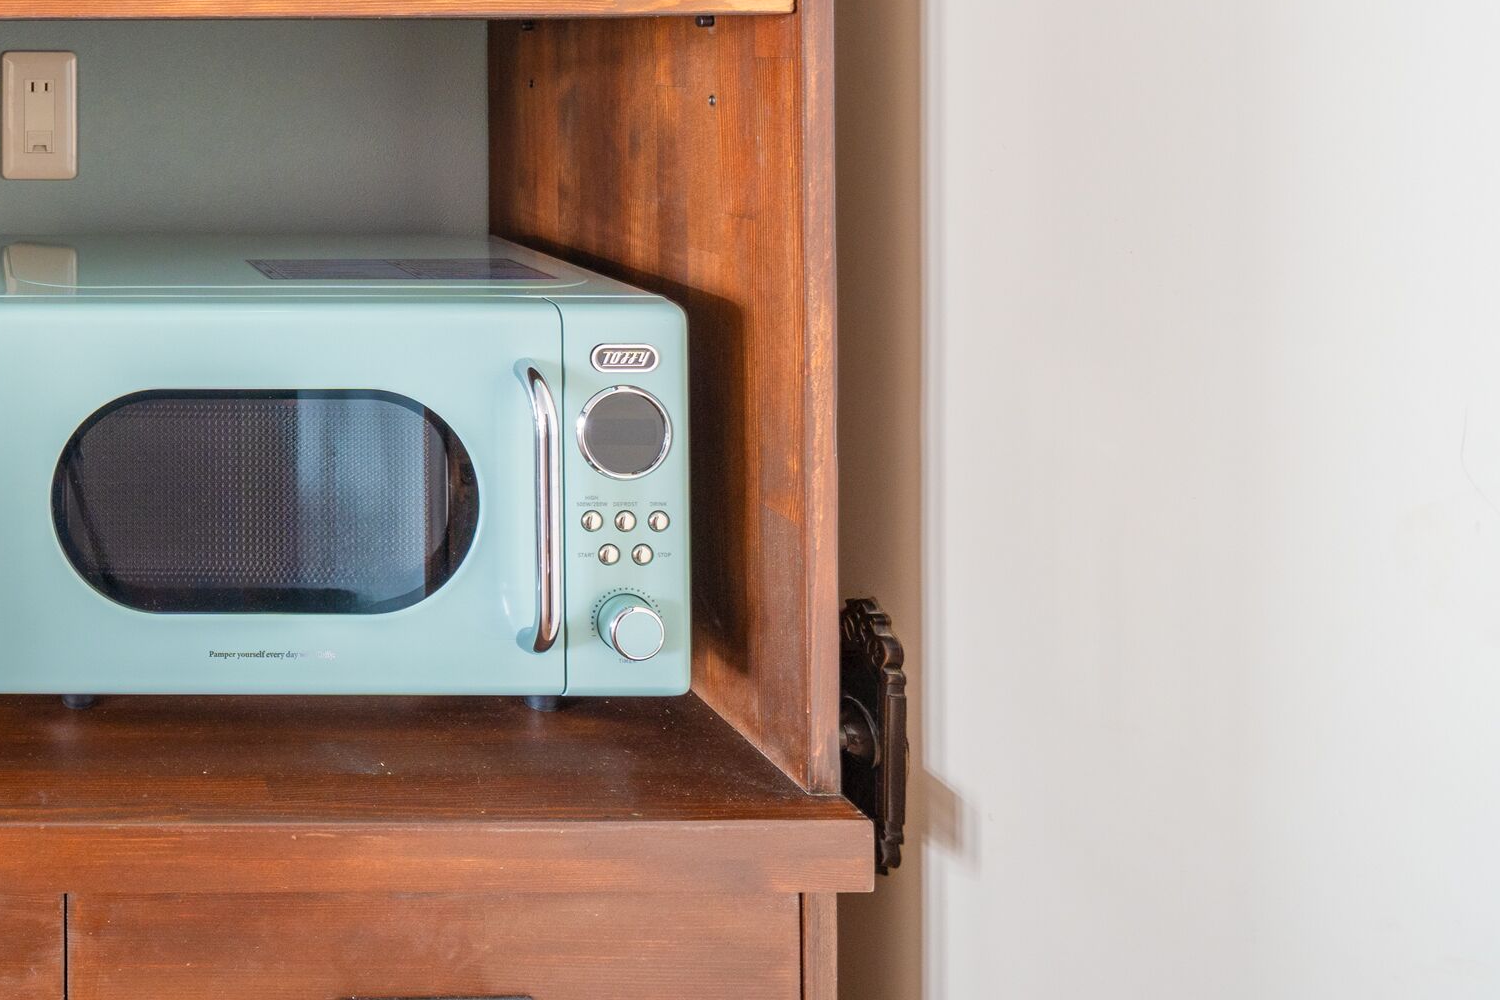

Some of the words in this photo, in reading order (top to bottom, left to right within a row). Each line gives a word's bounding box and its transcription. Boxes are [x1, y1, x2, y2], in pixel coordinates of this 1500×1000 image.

[209, 651, 236, 659] Pamper
[237, 650, 265, 660] yourself
[266, 651, 285, 660] every
[285, 650, 299, 660] day
